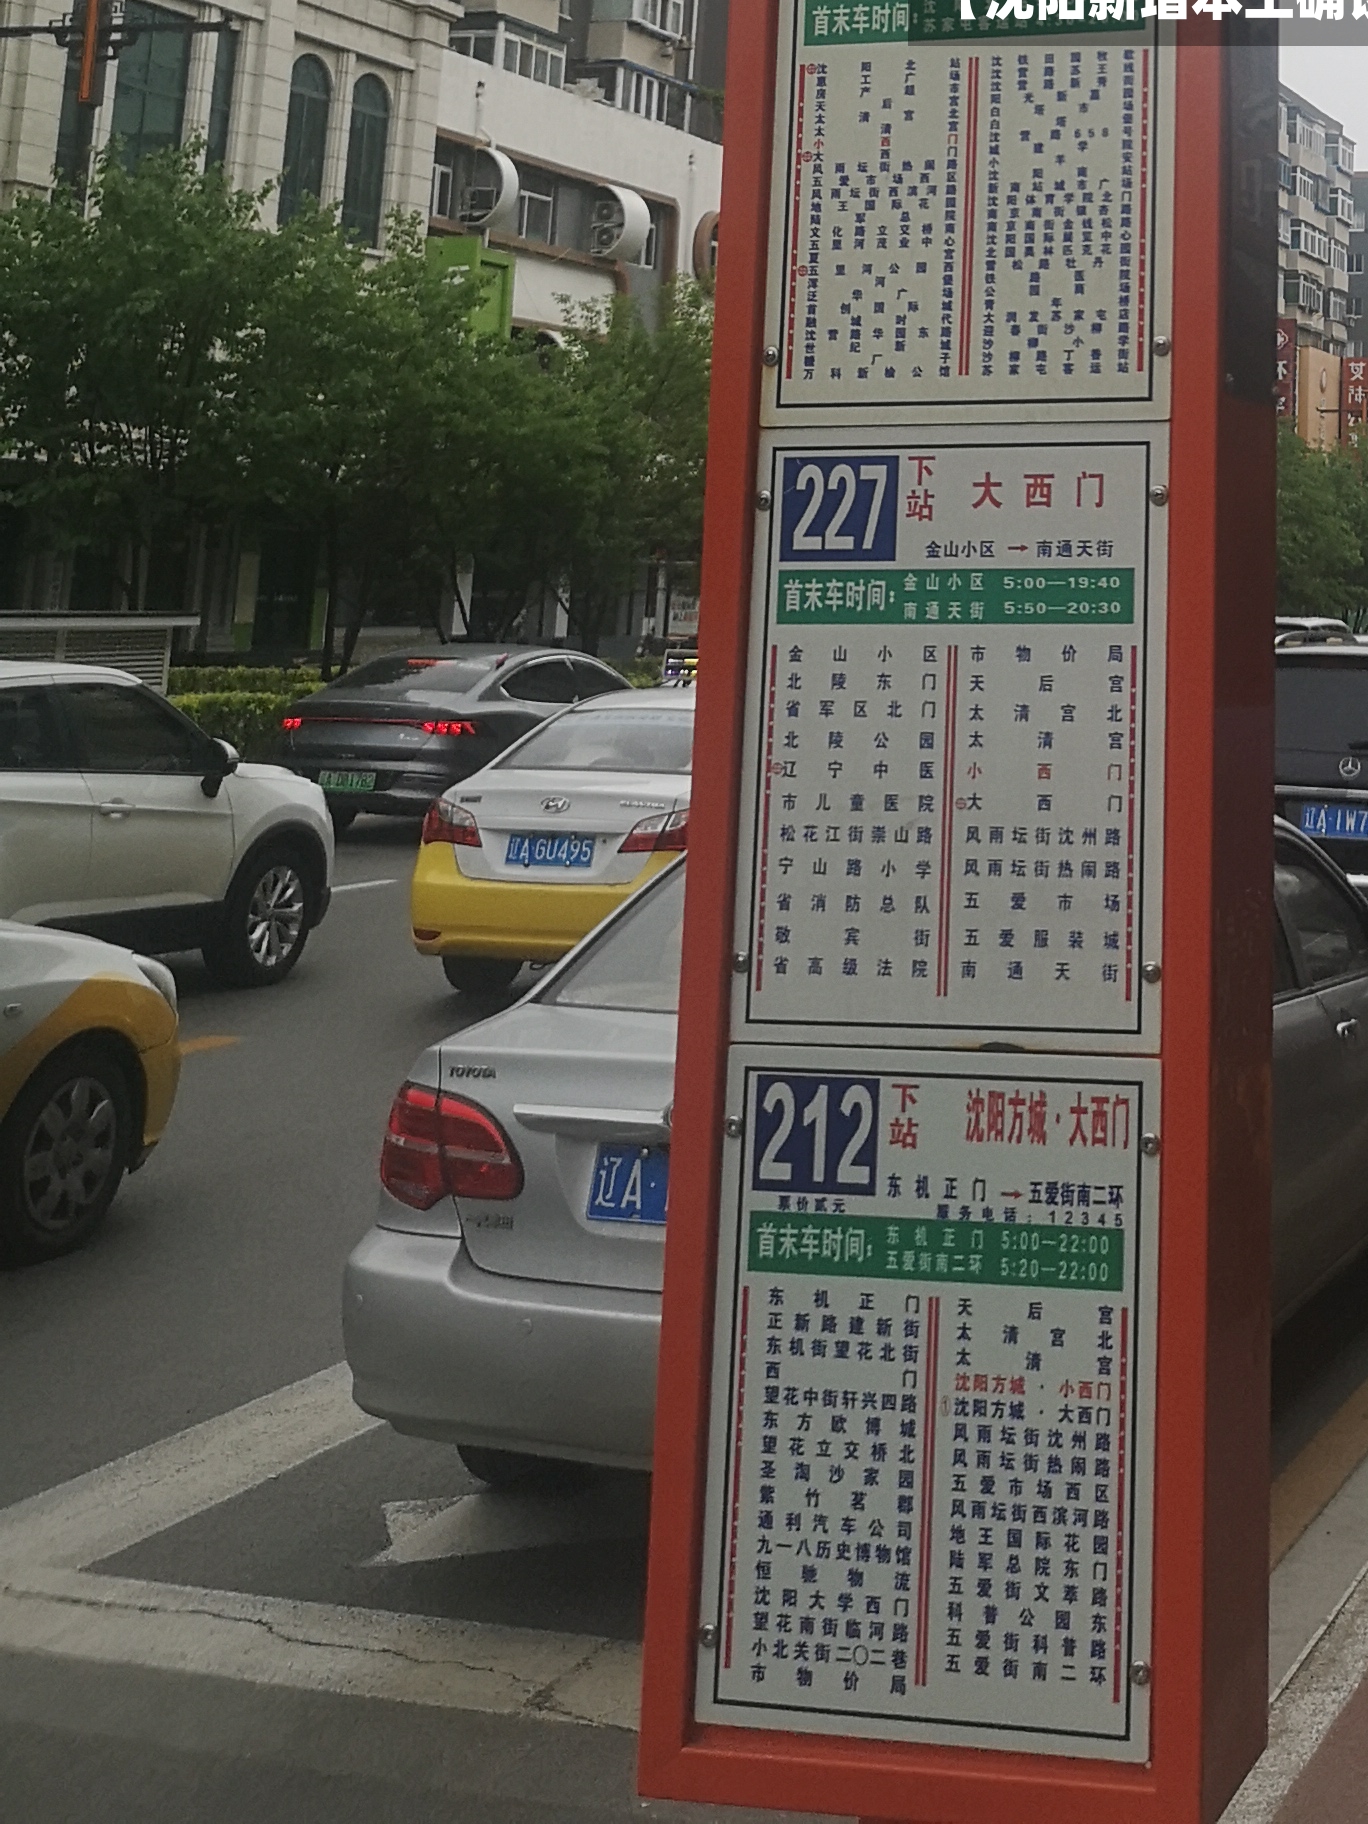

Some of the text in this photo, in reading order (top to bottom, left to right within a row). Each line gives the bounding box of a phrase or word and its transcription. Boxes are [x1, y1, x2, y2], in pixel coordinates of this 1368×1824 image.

[813, 146, 957, 162] 大西门
[814, 134, 958, 149] 小西门
[906, 456, 936, 522] 下站
[972, 472, 1104, 509] 大西门
[792, 464, 888, 550] 227
[925, 540, 1114, 558] 金山小区 南通天街
[904, 574, 984, 592] 金山小区
[904, 602, 984, 620] 南通天街
[789, 645, 938, 663] 金山小区
[971, 645, 1123, 663] 市物价局
[787, 673, 936, 691] 北陵东门
[970, 675, 1123, 693] 天后宫
[785, 701, 936, 718] 省军区北门
[969, 704, 1123, 723] 太清宫北
[784, 732, 935, 749] 北陵公园
[968, 731, 1123, 750] 太清宫
[783, 761, 935, 779] 辽宁中医
[968, 763, 1122, 781] 小西门
[782, 793, 935, 812] 市儿童医院
[967, 793, 1123, 813] 大西门
[780, 825, 932, 845] 松花江街崇山路
[966, 826, 1121, 846] 风雨坛街沈州路
[778, 858, 932, 878] 宁山路小学
[964, 859, 1121, 879] 风雨坛街热闹路
[777, 894, 930, 913] 省消防总队
[964, 893, 1121, 912] 五爱市场
[775, 927, 930, 947] 敬宾街
[964, 929, 1119, 950] 五爱服装城
[774, 957, 928, 978] 省高级法院
[961, 960, 1118, 982] 南通天街
[449, 1065, 496, 1078] TOYOTA
[889, 1084, 919, 1149] 下站
[966, 1089, 1130, 1149] 沈阳方城·大西门
[759, 1081, 873, 1184] 212
[887, 1174, 1124, 1209] 东机正门 五爱街南二环
[886, 1225, 984, 1248] 东机正门
[886, 1250, 982, 1275] 五爱街南二环
[768, 1286, 920, 1314] 东机正门
[958, 1298, 1113, 1324] 天后宫
[767, 1313, 920, 1339] 正新路建新街
[957, 1323, 1113, 1350] 太清宫北
[766, 1336, 918, 1363] 东机街望花北街
[956, 1348, 1112, 1376] 太清宫
[766, 1362, 917, 1388] 西门
[765, 1386, 917, 1413] 望花中街轩兴四路
[763, 1412, 916, 1438] 东方欧博城
[953, 1424, 1111, 1452] 风雨坛街沈州路
[761, 1435, 915, 1462] 望花立交桥北
[953, 1450, 1110, 1479] 风雨坛街热闹路
[951, 1474, 1110, 1503] 五爱市场西区
[758, 1509, 912, 1541] 通利汽车公司
[951, 1500, 1110, 1530] 风雨坛街西滨河路
[757, 1535, 912, 1568] 九一八历史博物馆
[950, 1524, 1109, 1555] 地王国际花园
[949, 1550, 1107, 1581] 陆军总院东门
[754, 1585, 909, 1618] 沈阳大学西门
[948, 1576, 1107, 1608] 五爱街文萃路
[753, 1611, 909, 1643] 望花南街临河路
[947, 1601, 1107, 1634] 科普公园东
[946, 1628, 1106, 1661] 五爱街科普路
[751, 1663, 906, 1695] 市物价局
[945, 1654, 1106, 1686] 五爱街南二环
